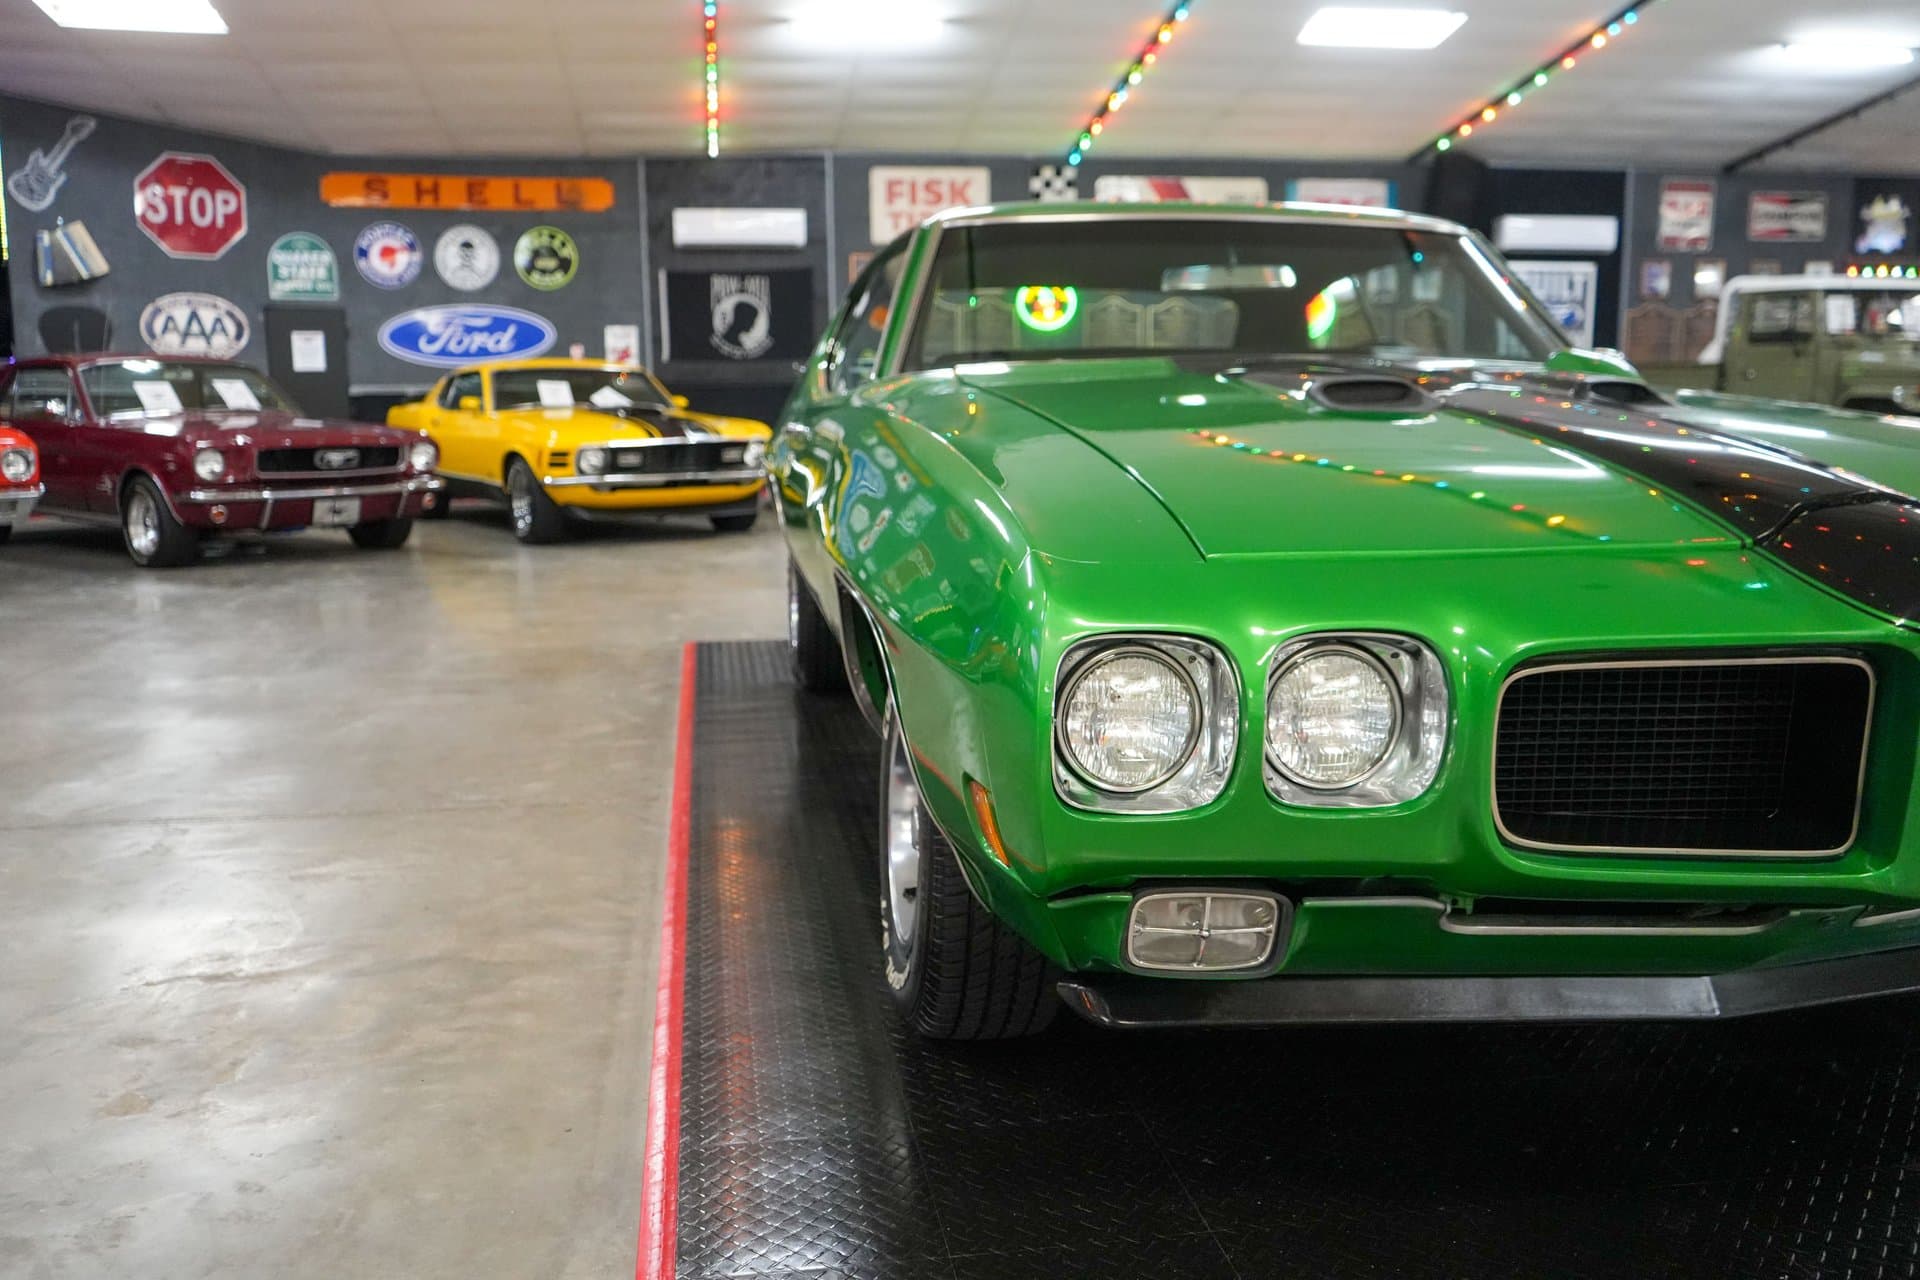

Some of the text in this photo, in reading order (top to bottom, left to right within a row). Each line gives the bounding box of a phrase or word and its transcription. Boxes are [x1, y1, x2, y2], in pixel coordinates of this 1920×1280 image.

[144, 183, 238, 229] STOP
[363, 178, 582, 207] SHELL
[886, 178, 971, 205] FISK
[161, 308, 230, 346] AAA
[418, 313, 518, 353] Ford
